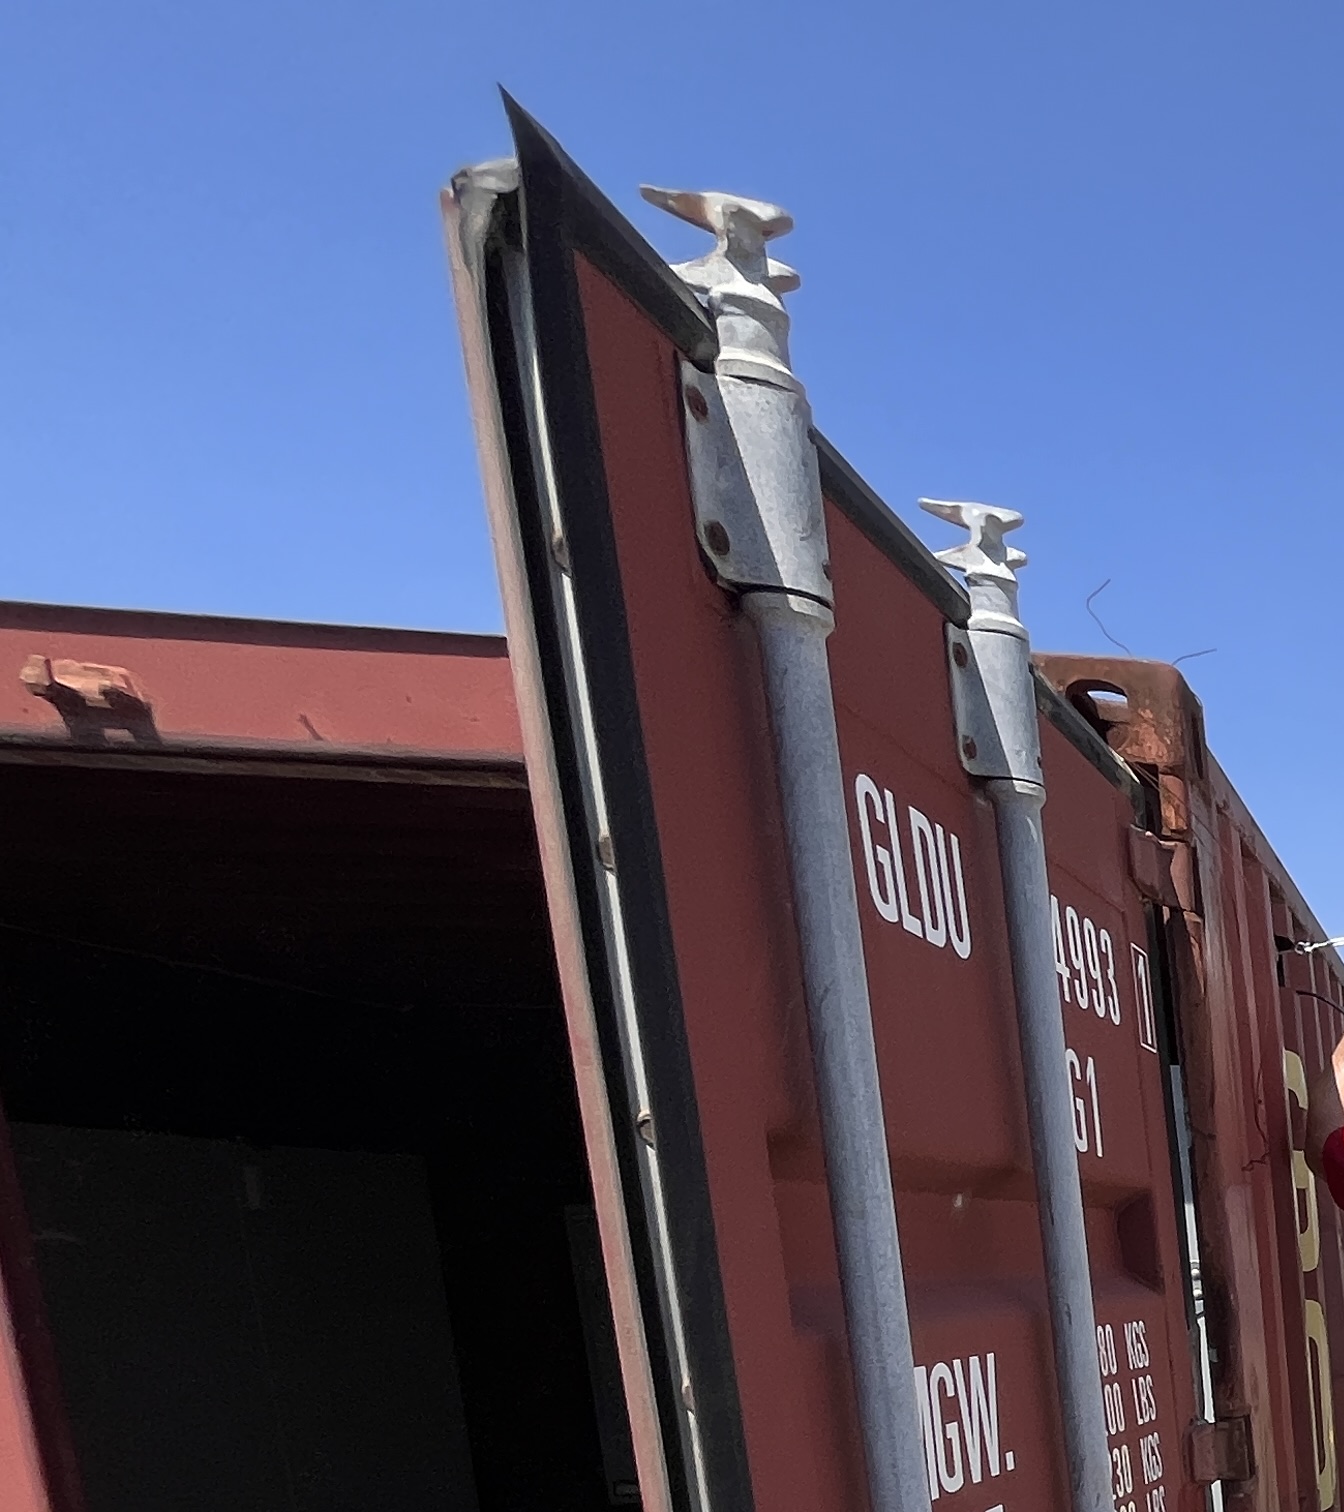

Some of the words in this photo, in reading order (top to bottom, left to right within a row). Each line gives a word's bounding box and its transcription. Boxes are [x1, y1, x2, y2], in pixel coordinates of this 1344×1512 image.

[855, 773, 972, 960] GLDU
[1050, 894, 1121, 1026] 4993
[1065, 1048, 1103, 1158] G1
[1096, 1323, 1119, 1377] 80
[1123, 1320, 1150, 1371] KGS
[1103, 1382, 1126, 1436] 00
[1131, 1374, 1157, 1426] LBS
[1111, 1444, 1134, 1500] 30
[1138, 1431, 1165, 1485] KGS
